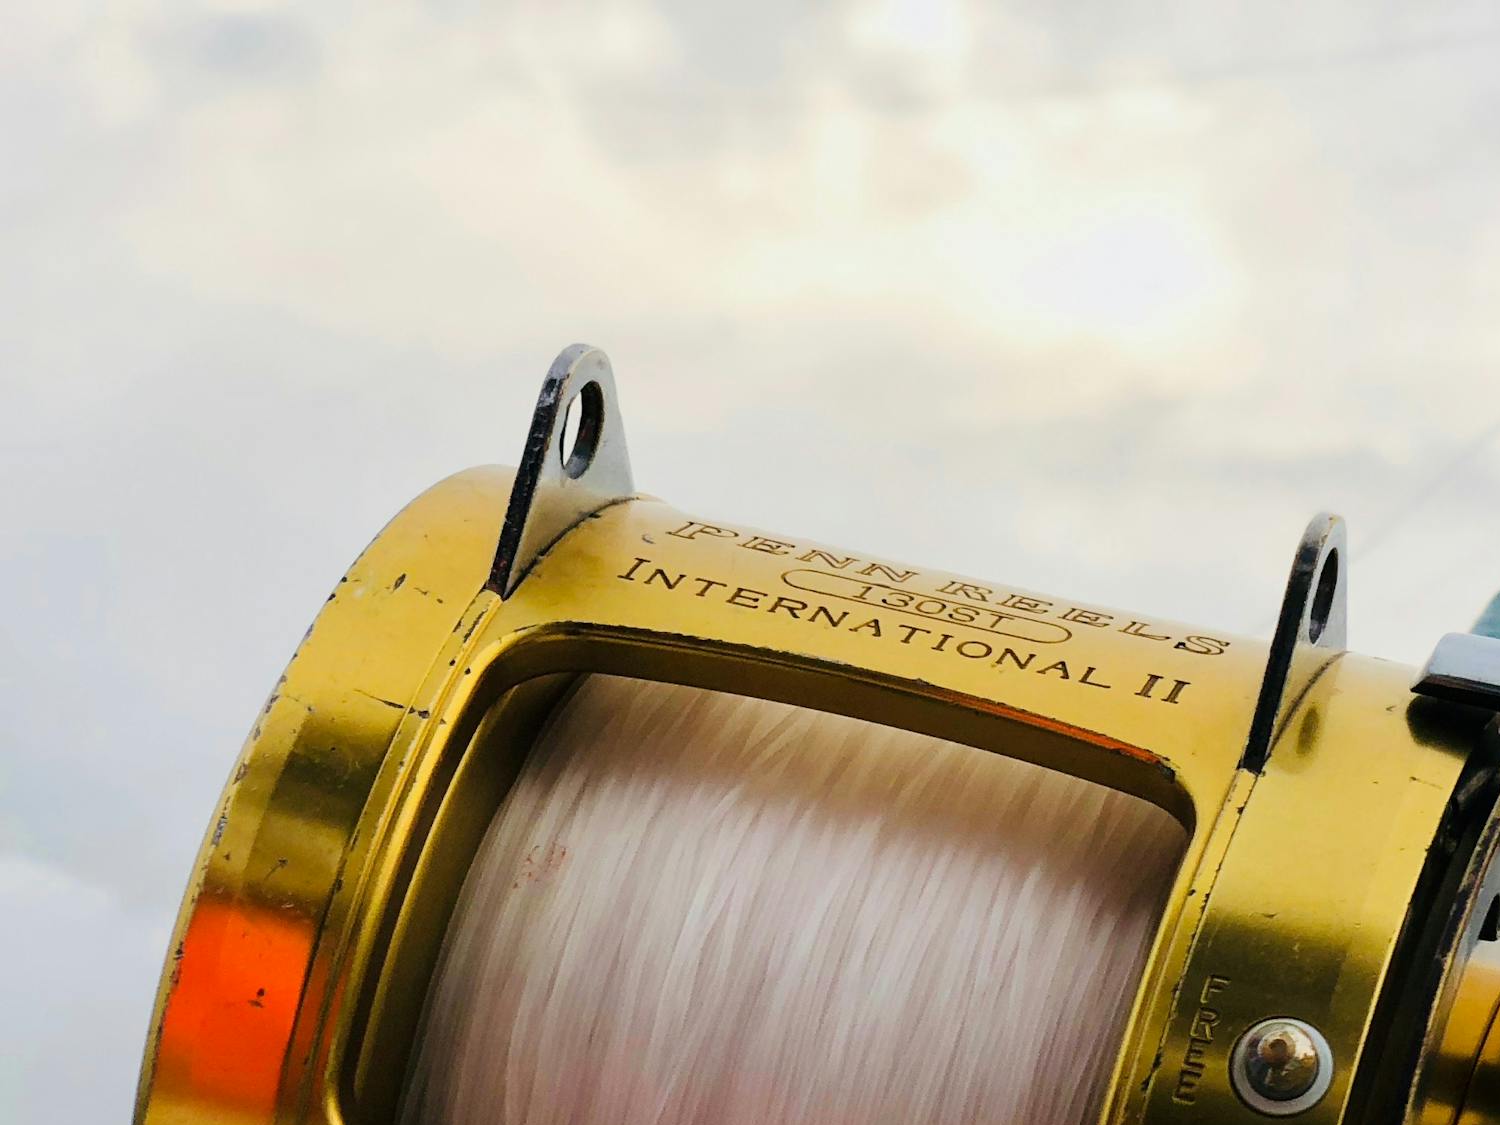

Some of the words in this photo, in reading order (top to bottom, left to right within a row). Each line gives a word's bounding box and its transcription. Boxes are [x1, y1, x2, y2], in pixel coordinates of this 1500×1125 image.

[617, 557, 1112, 690] INTERNATIONAL
[1135, 673, 1190, 704] II
[666, 520, 919, 584] PENN
[935, 580, 1231, 656] REELS
[852, 585, 1016, 630] 130ST
[1172, 974, 1231, 1105] FREE
